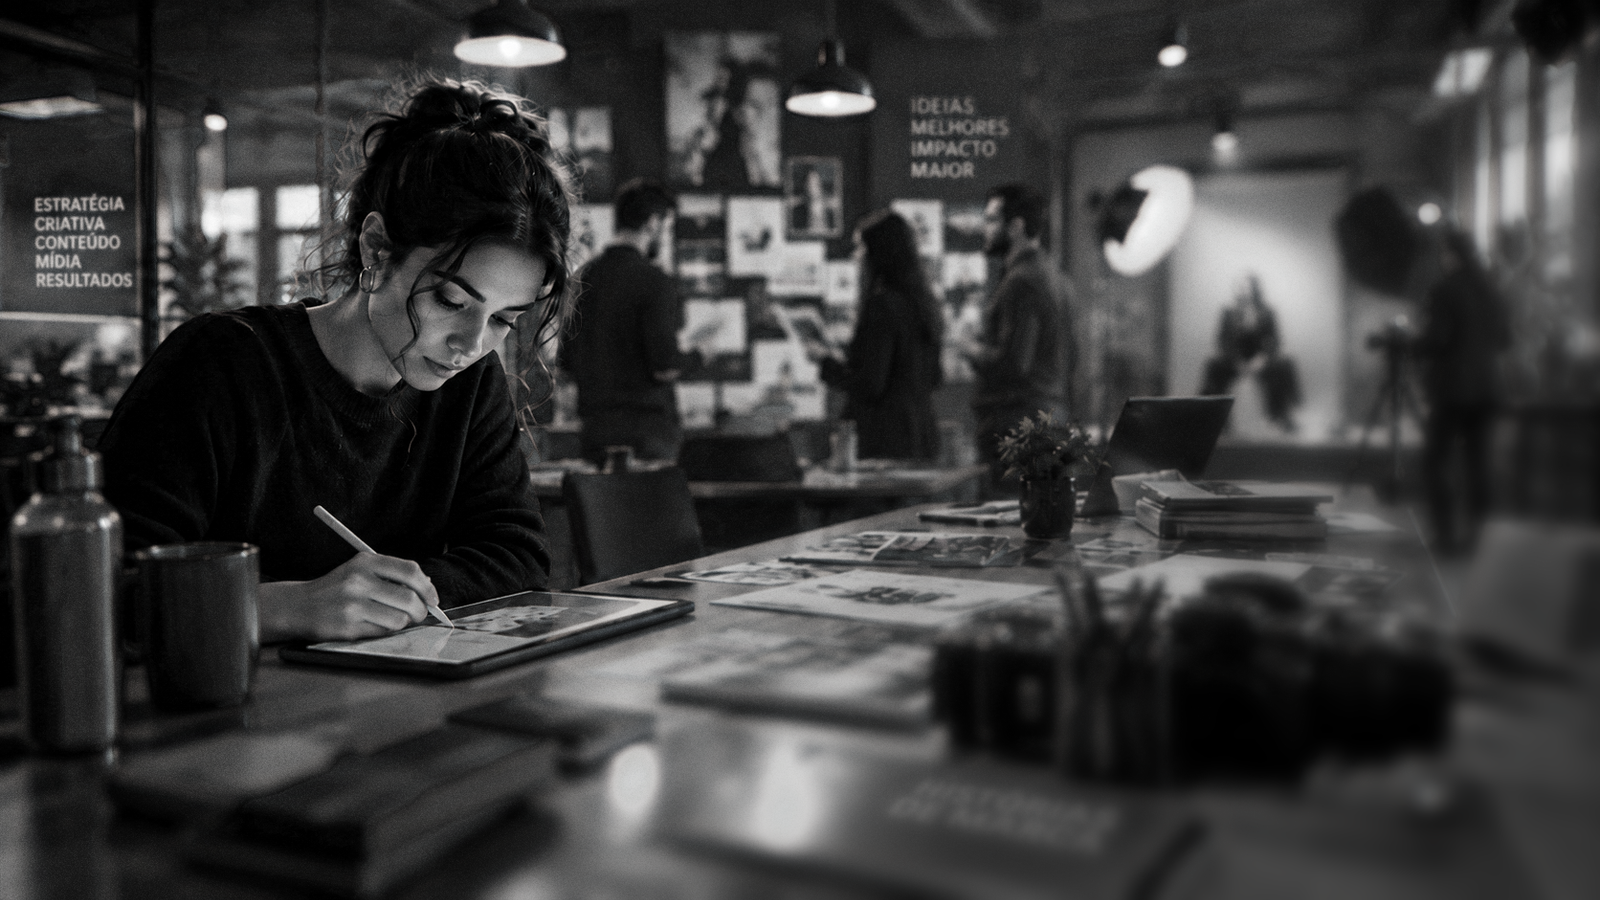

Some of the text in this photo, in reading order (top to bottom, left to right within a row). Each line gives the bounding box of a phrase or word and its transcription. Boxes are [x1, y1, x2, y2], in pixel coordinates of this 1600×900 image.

[911, 97, 975, 115] IDEIAS
[911, 118, 1009, 136] MELHORES
[911, 139, 997, 157] IMPACTO
[34, 193, 125, 212] ESTRATÉGIA
[34, 216, 105, 231] CRIATIVA
[34, 232, 121, 250] CONTEÚDO
[35, 251, 82, 269] MÍDIA
[36, 273, 133, 288] RESULTADOS
